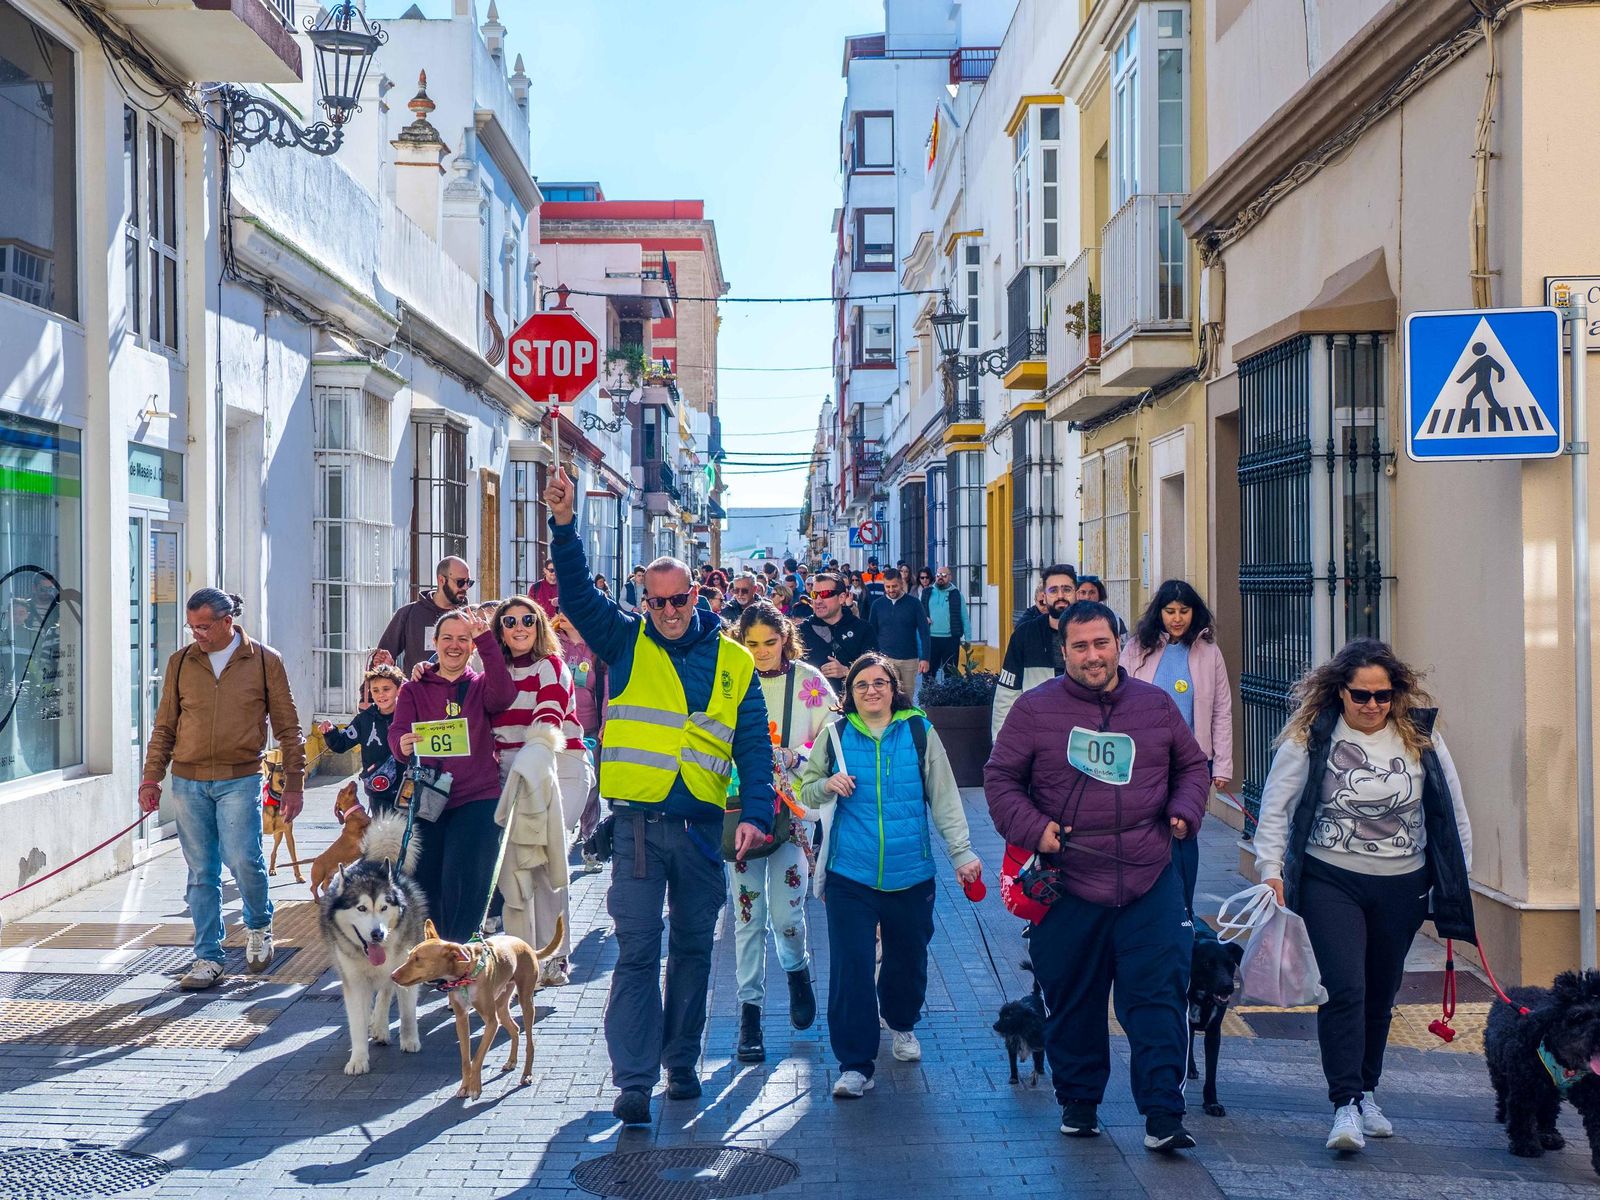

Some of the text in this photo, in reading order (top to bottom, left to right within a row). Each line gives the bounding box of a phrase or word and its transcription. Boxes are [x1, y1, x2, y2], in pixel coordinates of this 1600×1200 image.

[512, 339, 594, 377] STOP
[129, 461, 136, 477] de
[136, 462, 153, 483] Masaje
[430, 733, 453, 753] 59
[1087, 740, 1115, 766] 06
